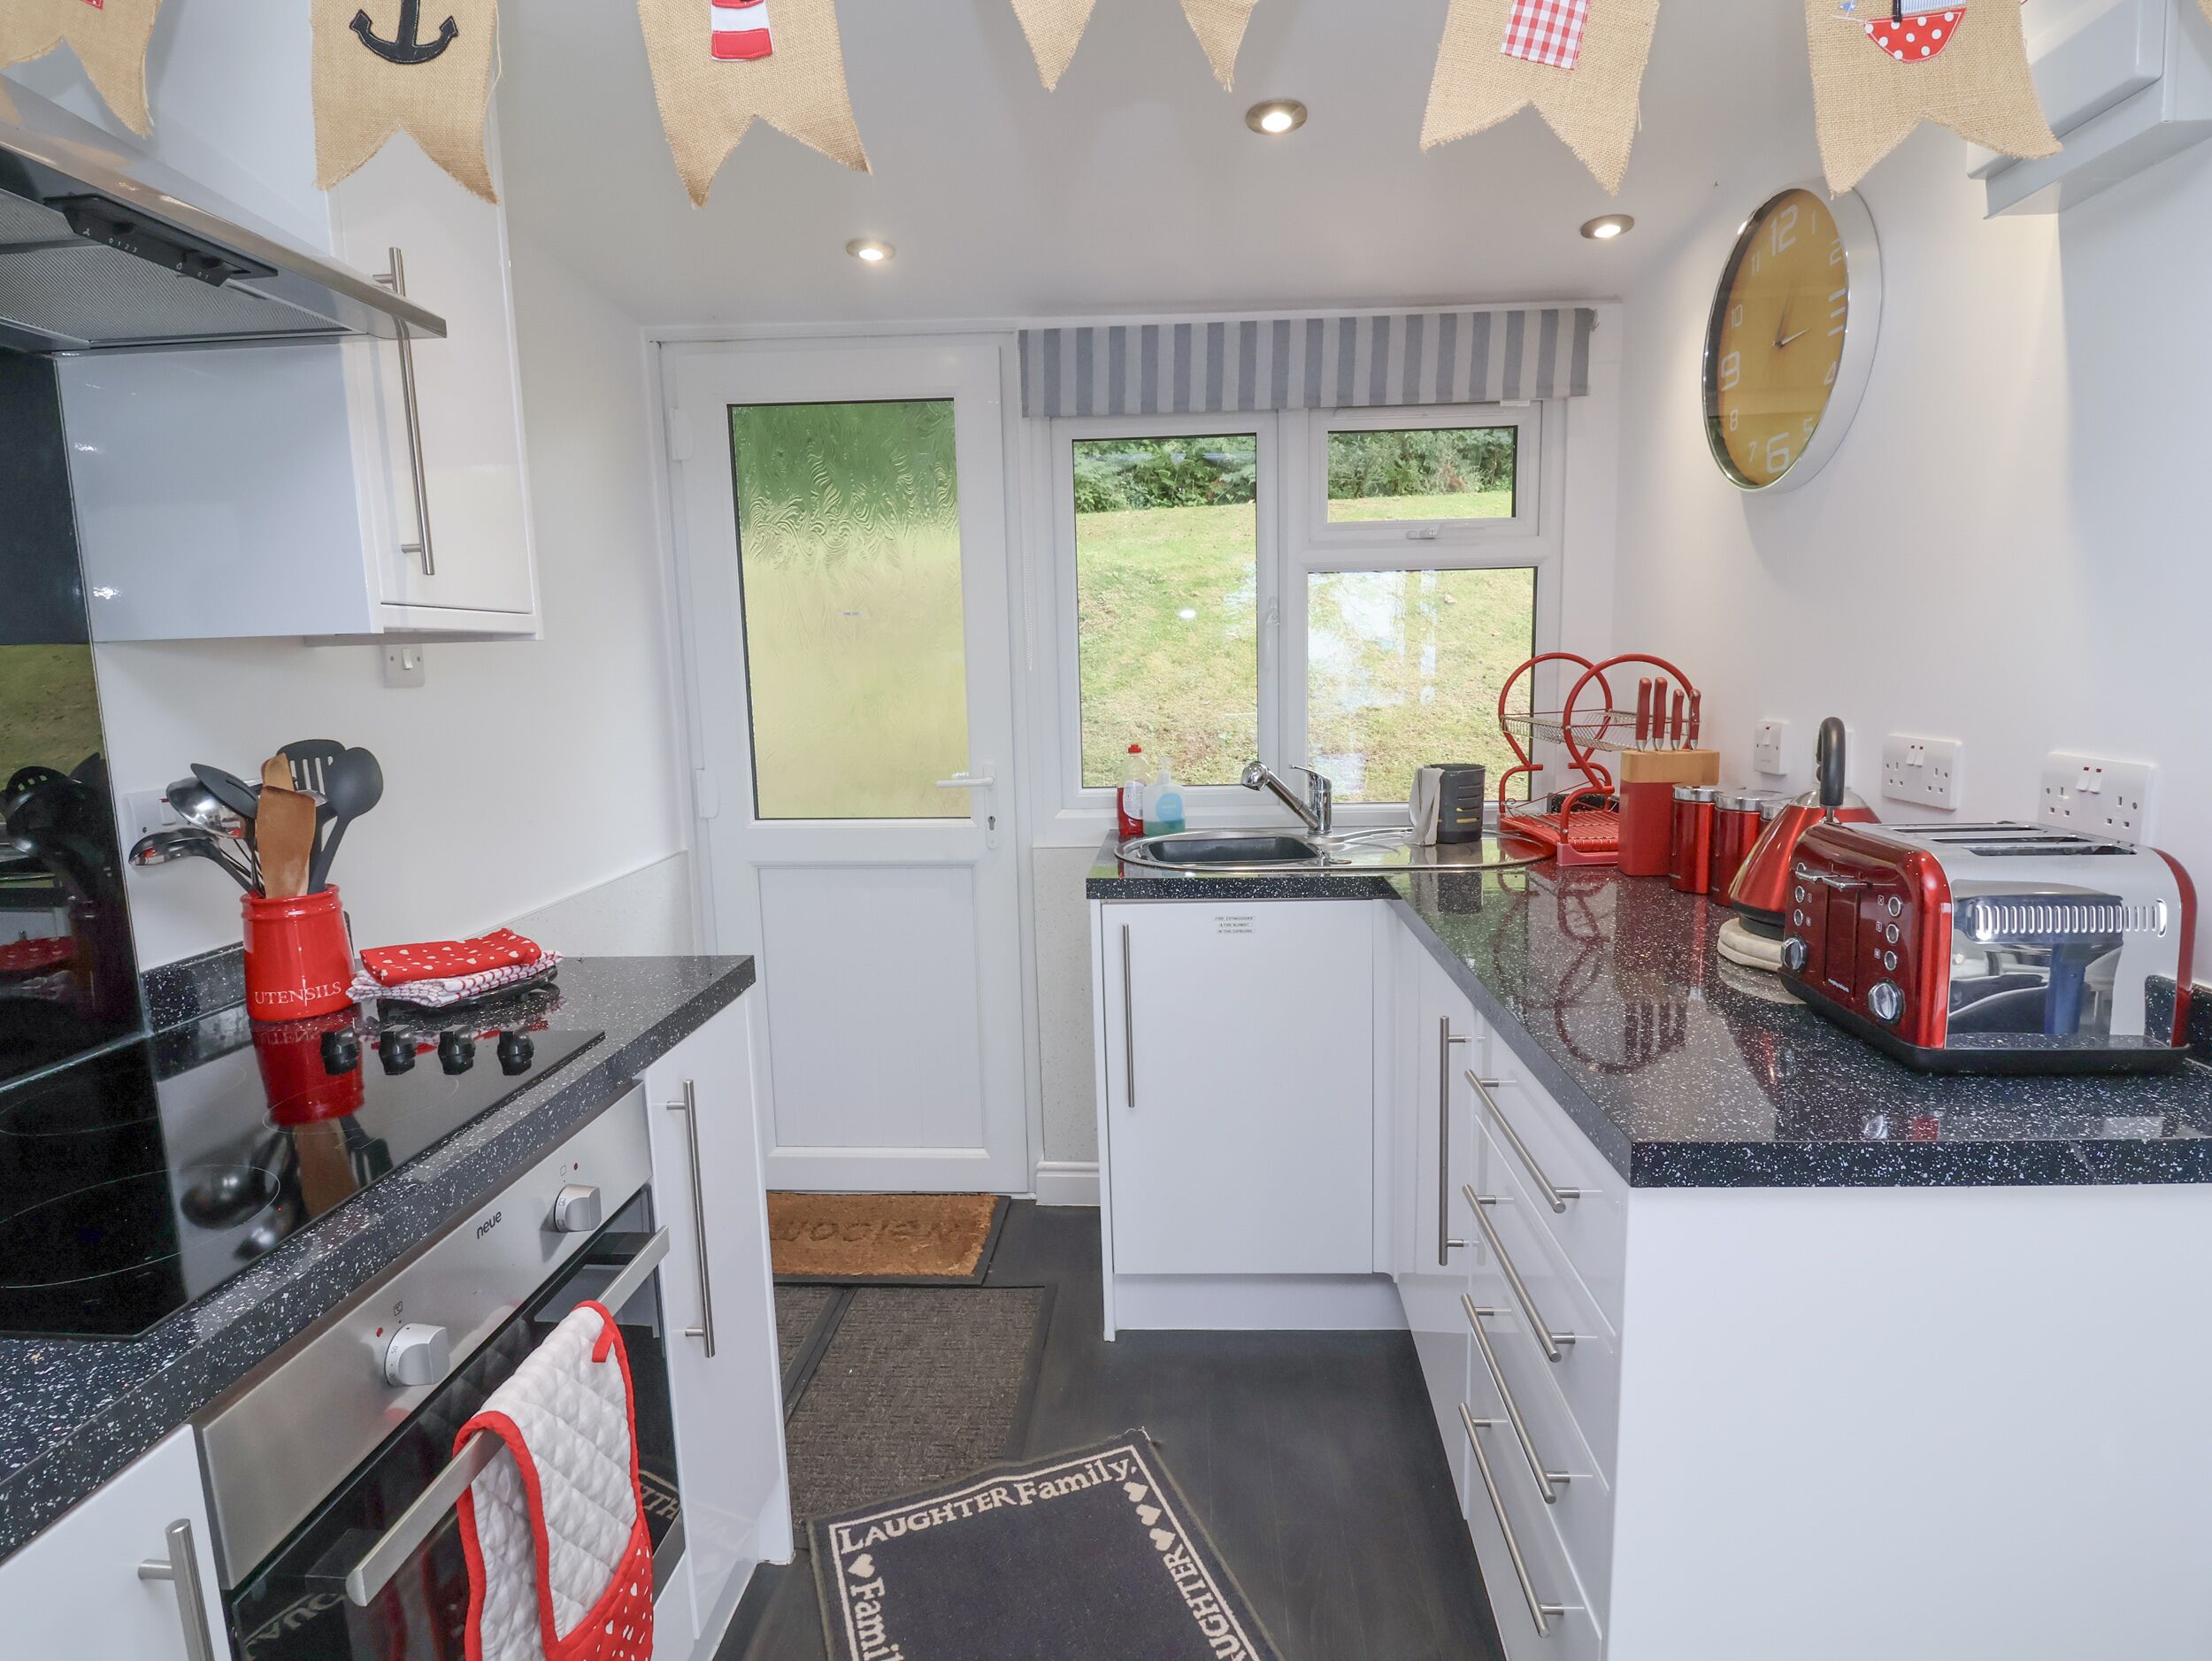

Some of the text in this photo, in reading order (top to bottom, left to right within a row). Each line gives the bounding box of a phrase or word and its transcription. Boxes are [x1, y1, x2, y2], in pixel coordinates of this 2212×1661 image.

[1770, 204, 1798, 256] 12
[1751, 252, 1760, 276] 11
[1829, 238, 1843, 266] 2
[1731, 304, 1743, 329] 10
[1720, 351, 1740, 392] 9
[1824, 361, 1837, 387] 4
[1730, 409, 1739, 432] 8
[1748, 441, 1758, 463] 7
[1766, 432, 1790, 474] 6
[254, 981, 342, 1004] UTENSILS
[476, 1211, 503, 1240] neue
[841, 1486, 1018, 1554] LAUGHTER
[1163, 1543, 1247, 1661] UGHTER
